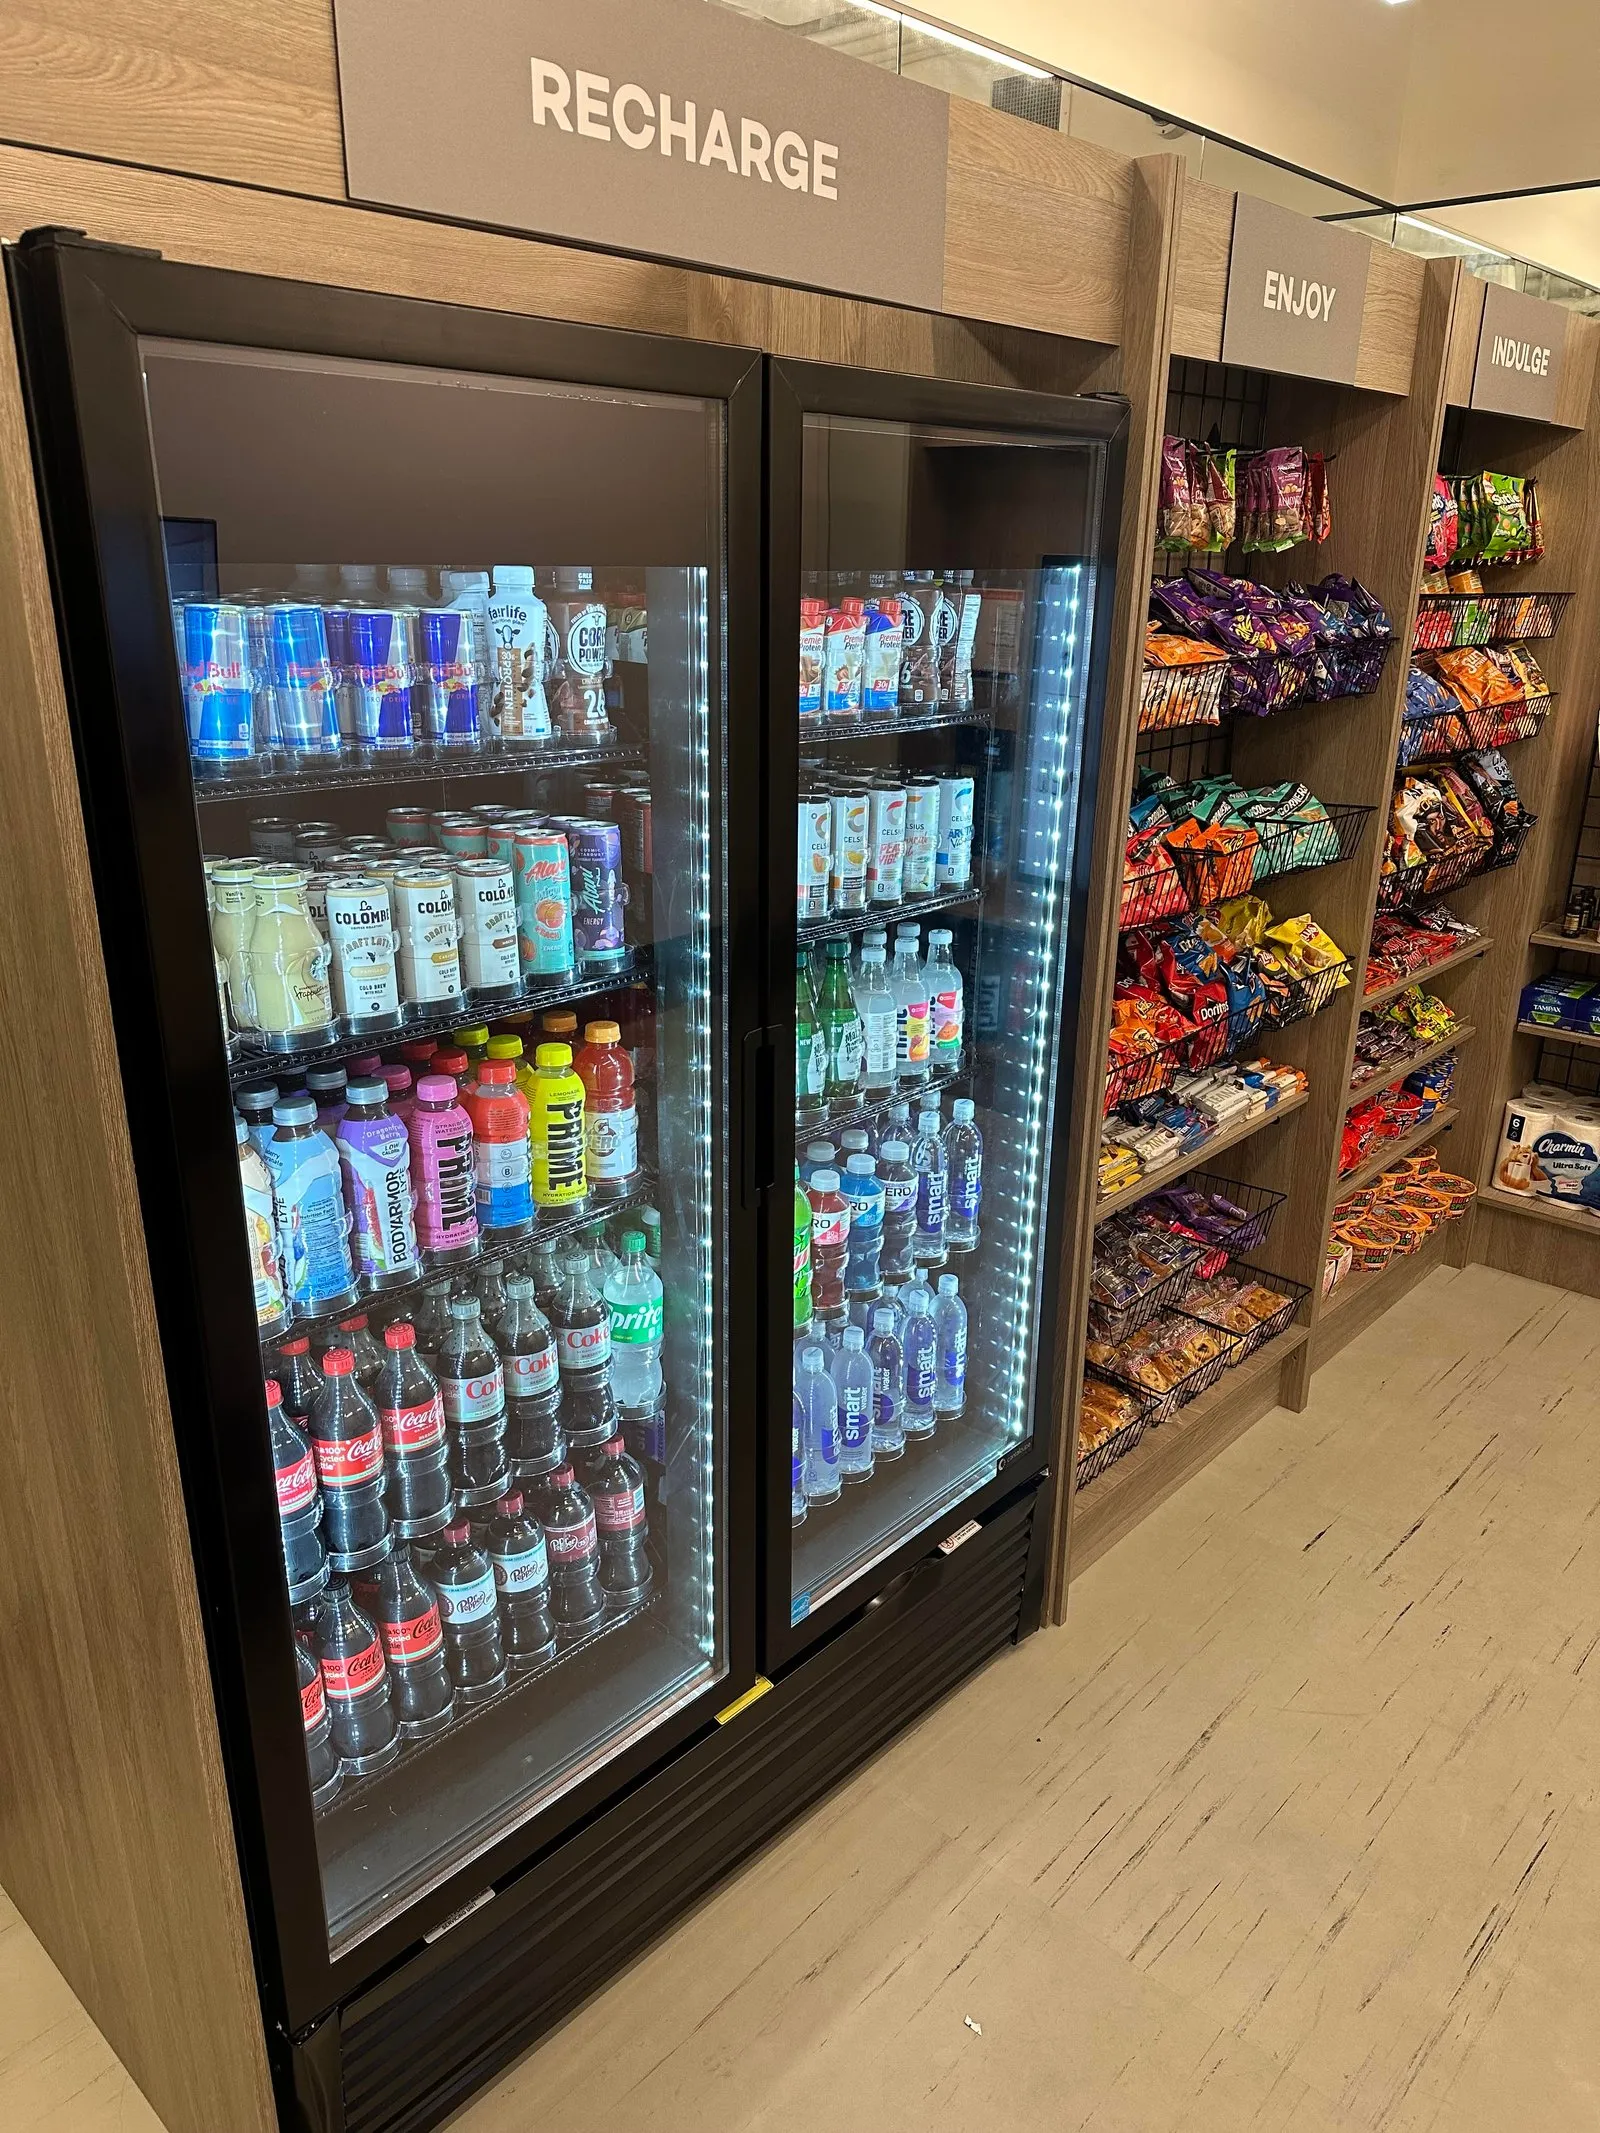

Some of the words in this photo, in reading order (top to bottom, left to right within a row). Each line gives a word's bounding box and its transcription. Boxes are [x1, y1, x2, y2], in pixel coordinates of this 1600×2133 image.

[530, 57, 838, 200] RECHARGE
[1263, 270, 1336, 322] ENJOY
[1491, 335, 1552, 377] INDULGE
[843, 634, 864, 645] Premie
[879, 633, 901, 645] Premie
[207, 661, 241, 680] Bull
[502, 660, 514, 710] PROTEIN
[497, 878, 507, 888] La
[440, 889, 449, 900] La
[359, 900, 373, 911] La
[583, 916, 604, 926] ENERGY
[1200, 1001, 1229, 1021] Doritos
[1533, 1004, 1562, 1013] TAMPAX
[1512, 1118, 1521, 1127] 6
[545, 1099, 585, 1192] PRIME
[1538, 1138, 1586, 1157] Charmin
[1552, 1161, 1574, 1170] Ultra
[1574, 1163, 1592, 1172] Soft
[436, 1131, 477, 1232] PRIME
[964, 1157, 980, 1210] smart
[885, 1187, 913, 1198] ERO
[927, 1172, 944, 1225] smart
[276, 1197, 289, 1224] LYTE
[851, 1201, 868, 1212] RO
[386, 1169, 407, 1266] BODYARMOR
[812, 1218, 830, 1229] RO
[567, 1325, 610, 1351] Coke
[514, 1350, 558, 1377] Coke
[917, 1346, 935, 1399] smart
[465, 1371, 505, 1400] Coke
[882, 1366, 891, 1391] water
[844, 1386, 861, 1441] smart
[521, 1564, 532, 1575] Dr
[467, 1593, 478, 1604] Dr
